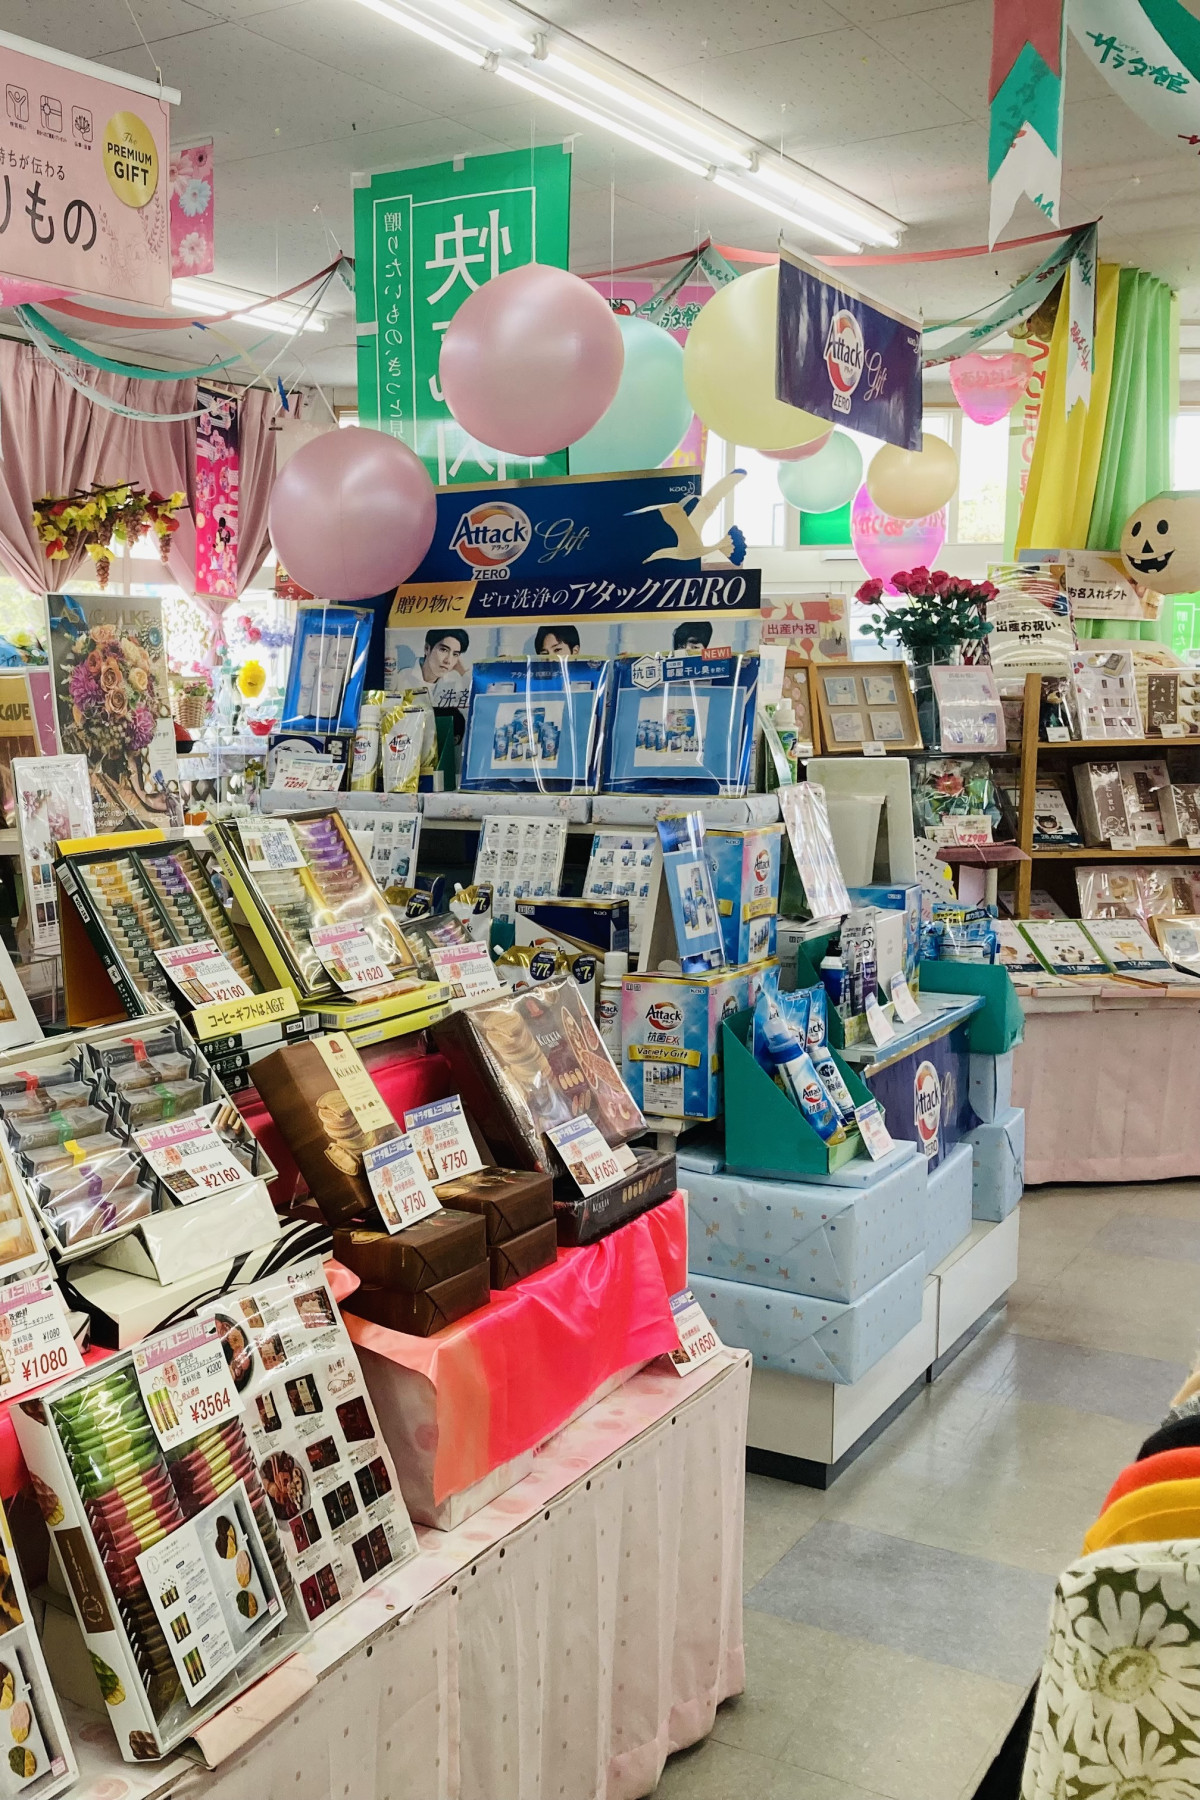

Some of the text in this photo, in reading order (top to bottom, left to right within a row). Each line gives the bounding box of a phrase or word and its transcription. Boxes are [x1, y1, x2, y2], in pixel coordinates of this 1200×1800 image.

[1086, 31, 1189, 94] サラダ館
[106, 142, 152, 167] PREMIUM
[113, 162, 150, 186] GIFT
[826, 328, 862, 368] Attack
[833, 393, 851, 411] ZERO
[451, 514, 528, 550] Attack
[474, 568, 508, 580] ZERO
[396, 593, 464, 615] 贈り物に
[767, 623, 818, 636] 出産内祝
[704, 648, 731, 660] NEW!
[355, 965, 385, 983] ¥1620
[213, 984, 245, 1002] ¥2160
[207, 996, 285, 1028] コーヒーギフトはAGF
[645, 1004, 682, 1022] Attack
[637, 1048, 688, 1059] Variety Gift
[915, 1081, 940, 1119] Attack
[440, 1149, 468, 1173] ¥750
[591, 1158, 619, 1182] ¥1650
[201, 1167, 241, 1189] ¥2160
[401, 1190, 427, 1216] ¥750
[688, 1332, 717, 1360] ¥1650
[21, 1346, 68, 1382] ¥1080
[189, 1387, 231, 1424] ¥3564
